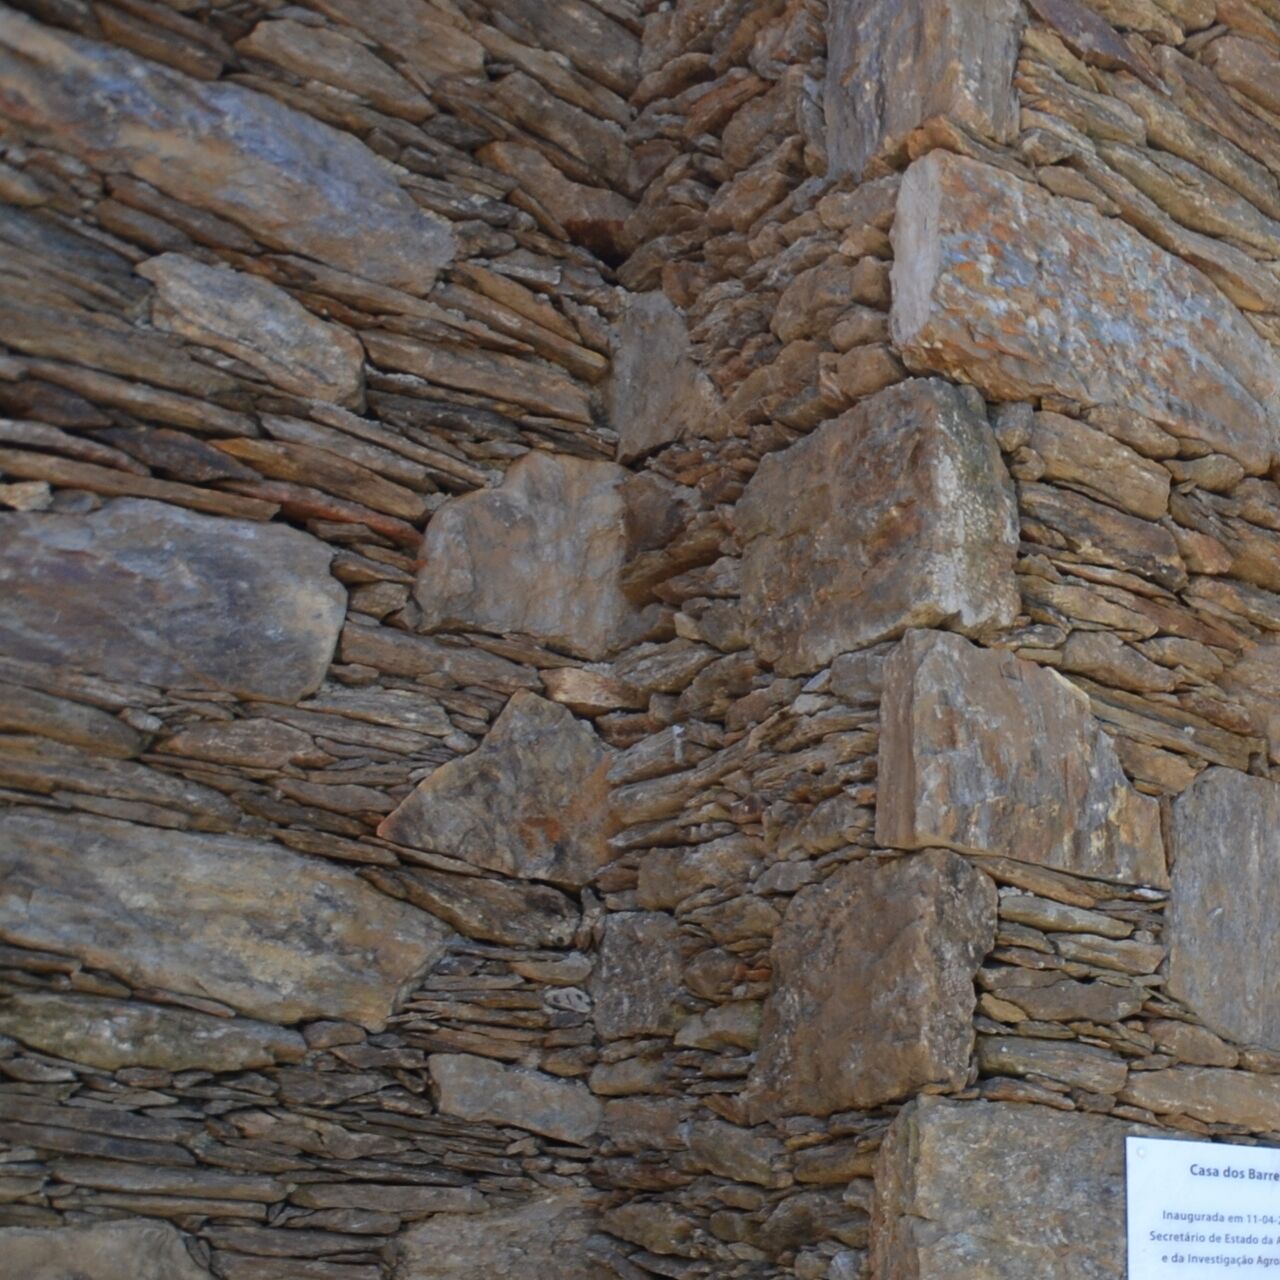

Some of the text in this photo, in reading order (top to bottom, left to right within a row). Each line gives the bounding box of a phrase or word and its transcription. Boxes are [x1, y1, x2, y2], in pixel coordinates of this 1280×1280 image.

[1189, 1163, 1219, 1177] Casa
[1222, 1165, 1245, 1179] dos
[1162, 1209, 1225, 1224] Inaugurada
[1227, 1215, 1243, 1223] em
[1149, 1230, 1206, 1243] Secretário
[1208, 1232, 1222, 1243] de
[1224, 1233, 1259, 1245] Estado
[1261, 1234, 1273, 1245] da
[1161, 1254, 1168, 1263] e
[1171, 1252, 1185, 1263] da
[1187, 1253, 1254, 1267] Investigação
